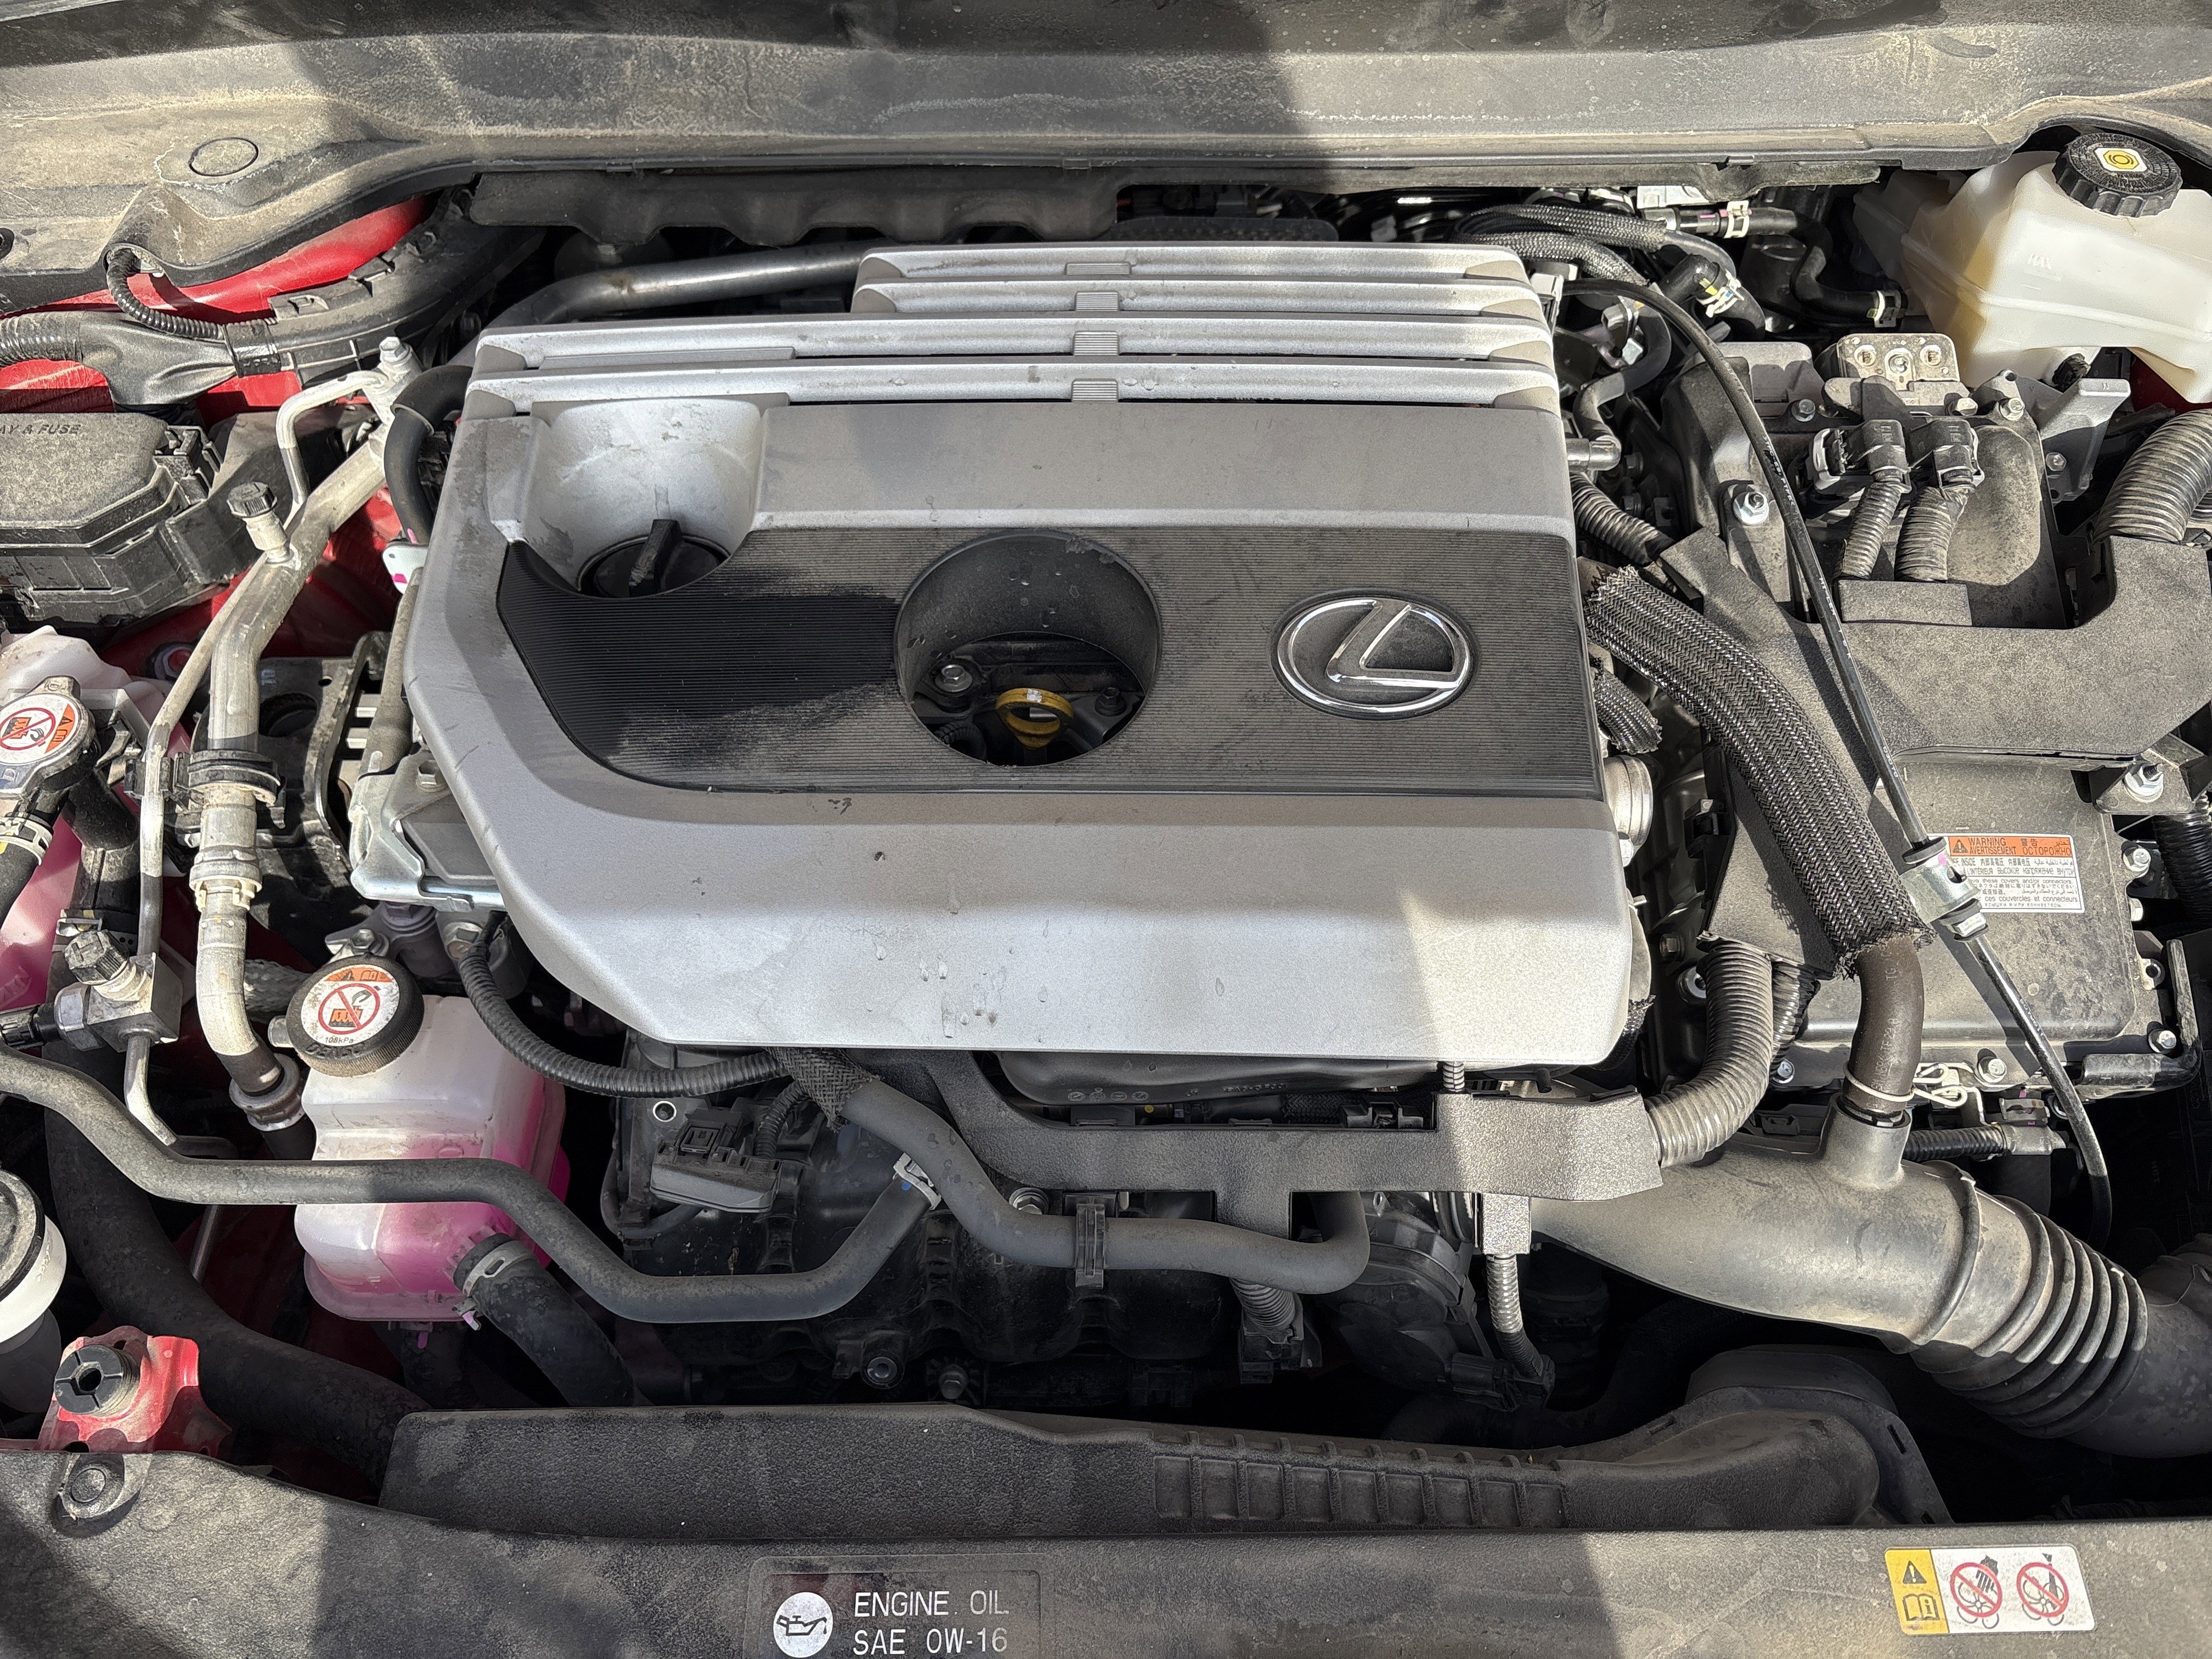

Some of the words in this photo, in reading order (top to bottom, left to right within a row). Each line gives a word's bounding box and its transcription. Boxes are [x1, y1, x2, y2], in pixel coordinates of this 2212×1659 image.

[37, 424, 81, 434] FUSE
[1968, 837, 2006, 846] WARNING
[1970, 846, 2017, 855] AVERTISSEMENT
[2022, 846, 2072, 856] ОСТОРОЖНО
[854, 1591, 950, 1617] ENGINE
[970, 1590, 1009, 1615] OIL
[853, 1628, 906, 1656] SAE
[926, 1627, 1008, 1654] 0W-16
